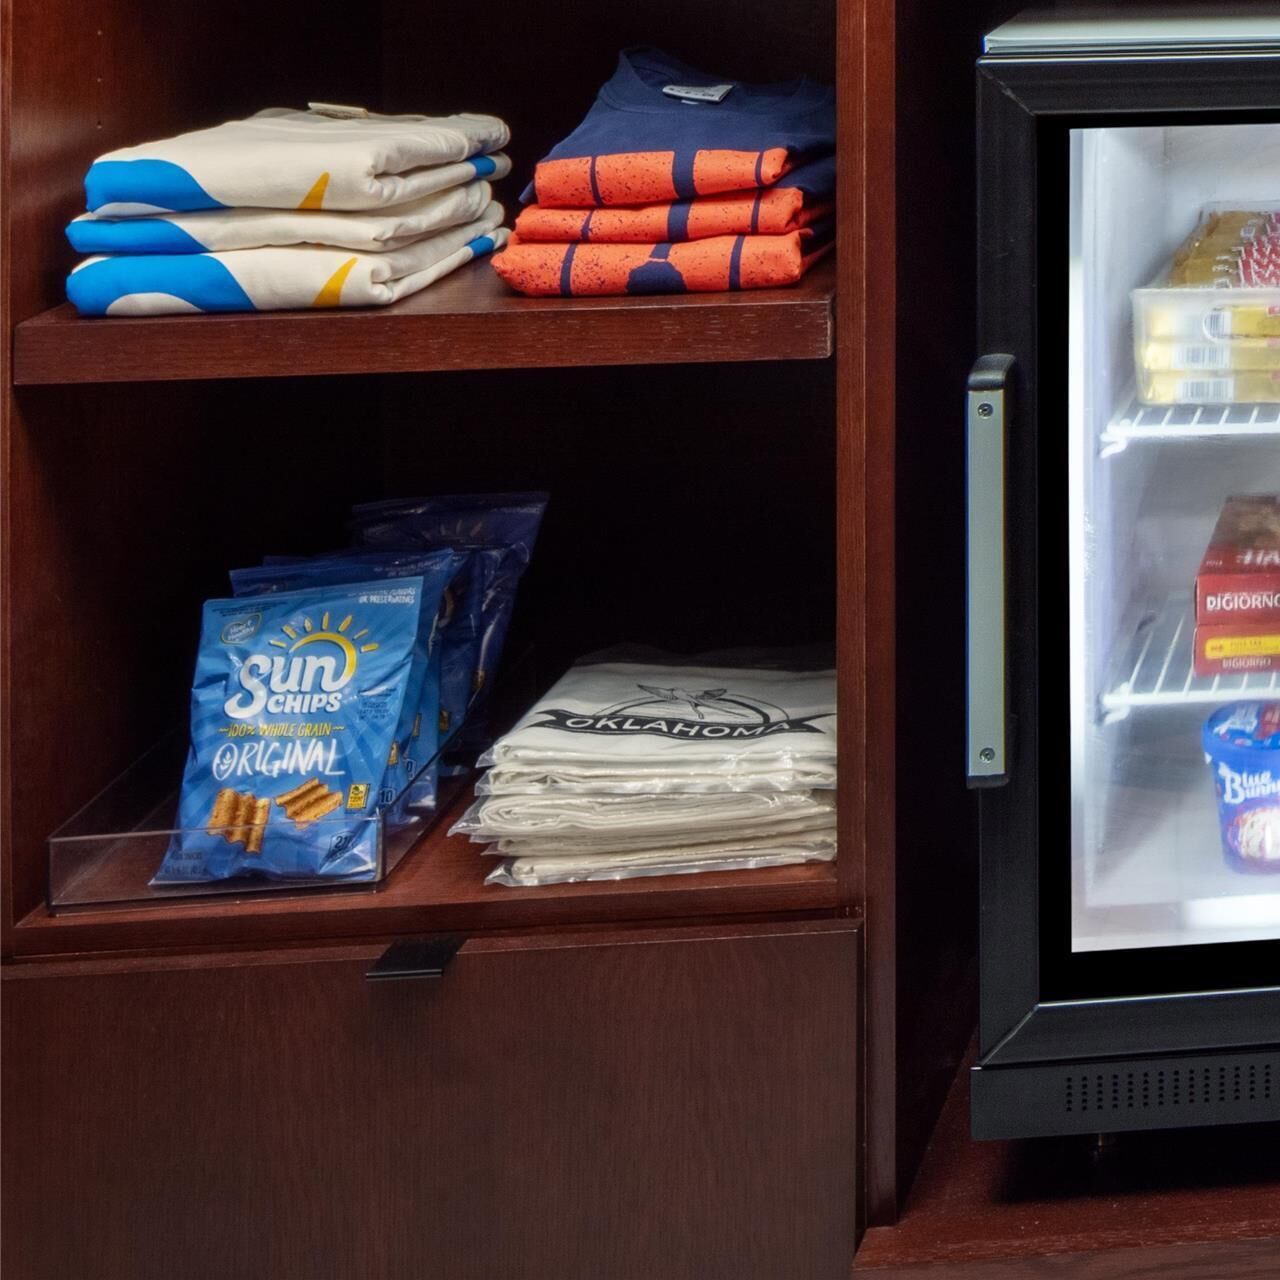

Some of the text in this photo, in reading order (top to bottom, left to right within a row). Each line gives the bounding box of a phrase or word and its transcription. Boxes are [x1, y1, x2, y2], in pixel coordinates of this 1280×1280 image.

[224, 642, 357, 720] Sun
[267, 693, 342, 713] CHIPS
[228, 723, 331, 737] 100% WHOLE GRAIN
[566, 717, 791, 739] OKLAHOMA
[212, 739, 346, 781] ORIGINAL
